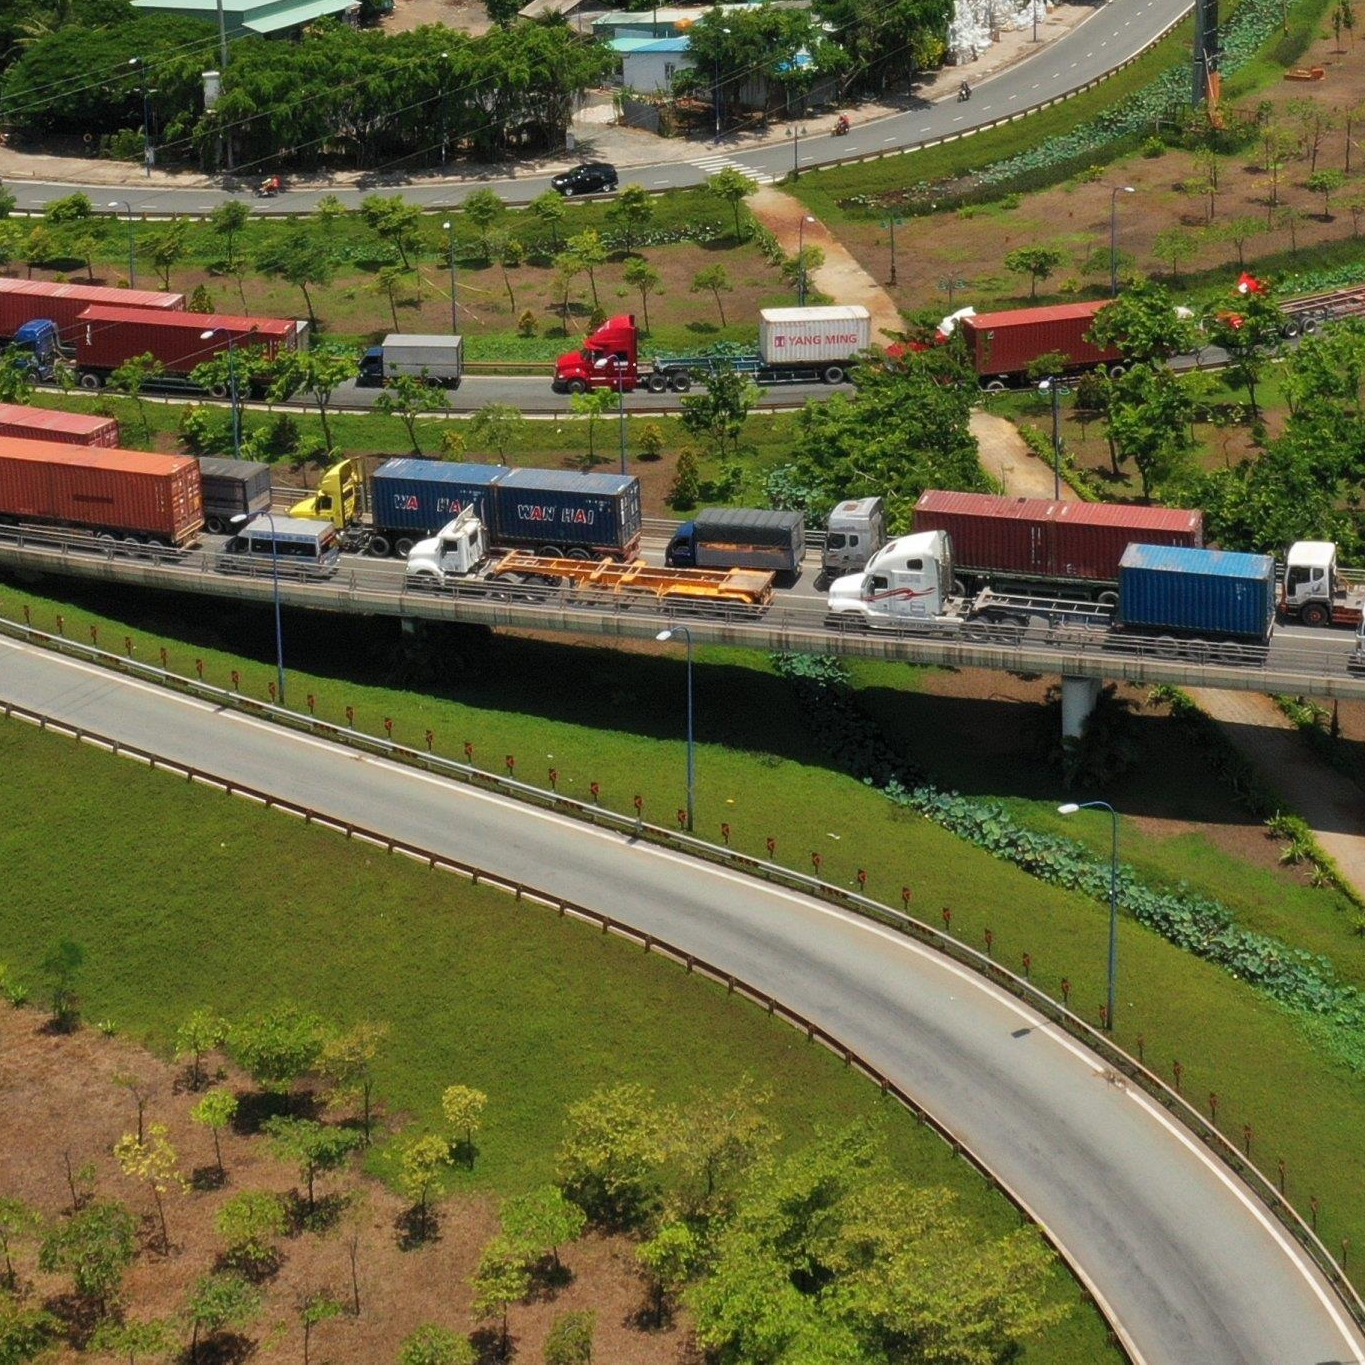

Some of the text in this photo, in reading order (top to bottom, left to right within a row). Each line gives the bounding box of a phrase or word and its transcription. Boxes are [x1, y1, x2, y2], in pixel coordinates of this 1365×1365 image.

[788, 335, 857, 345] YANG MING
[517, 504, 555, 522] WAN
[561, 507, 594, 525] HAI
